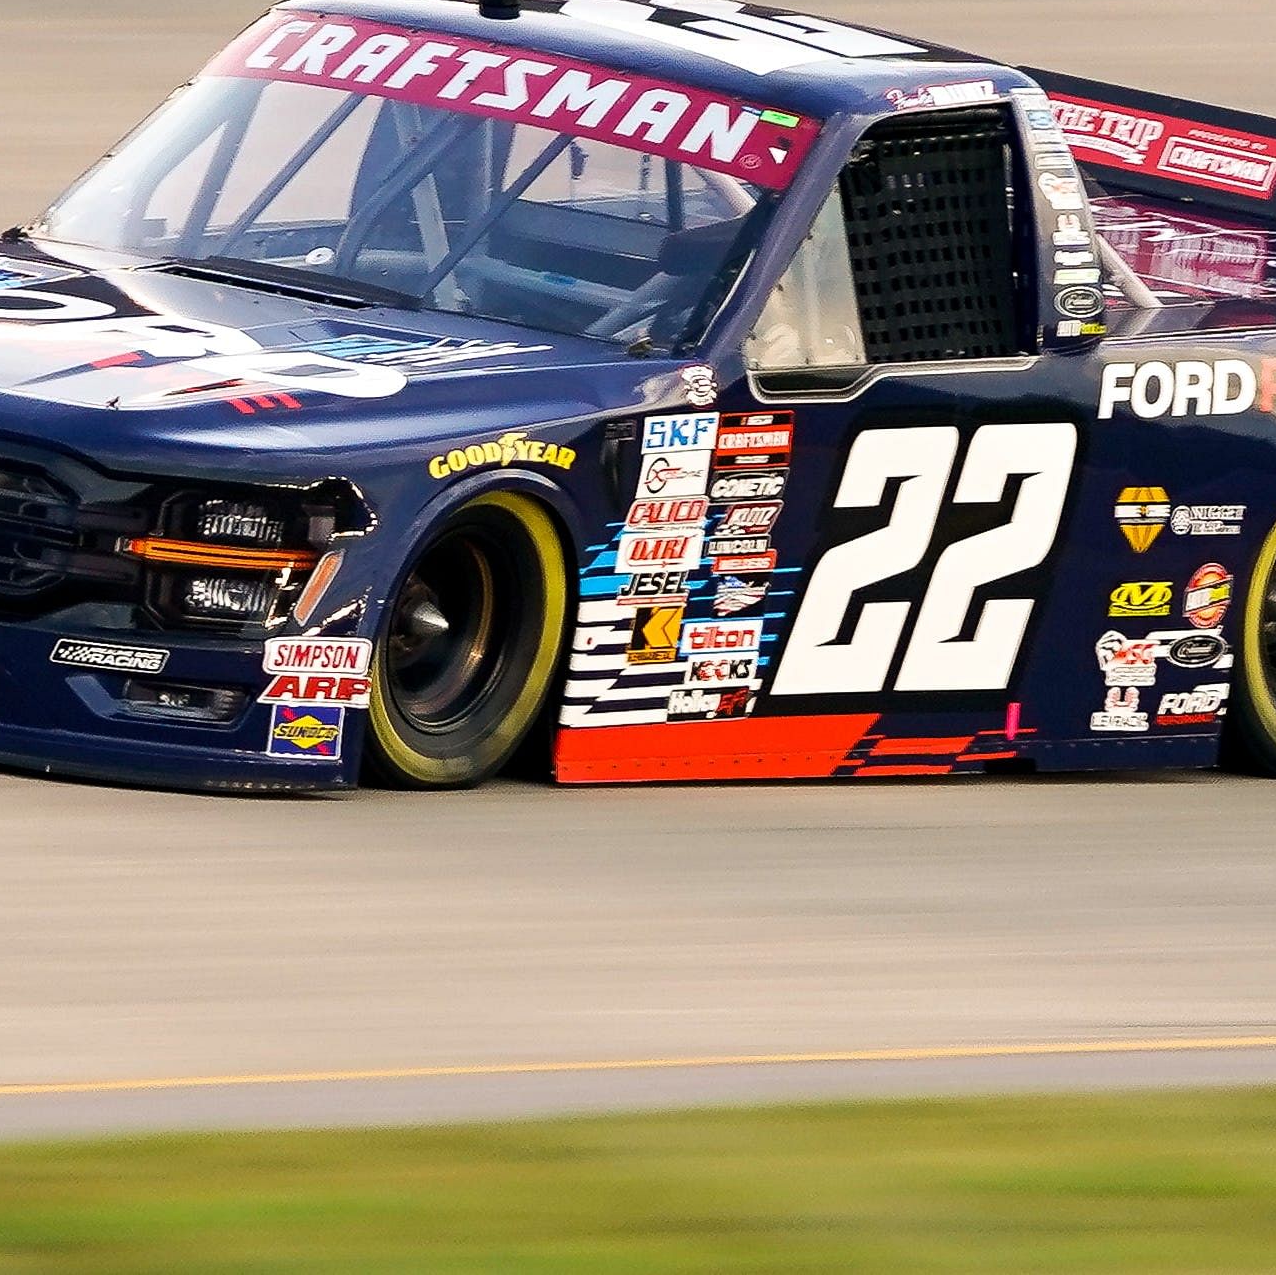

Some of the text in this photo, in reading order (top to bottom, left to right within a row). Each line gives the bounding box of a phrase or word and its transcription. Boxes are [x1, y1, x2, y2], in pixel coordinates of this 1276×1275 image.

[244, 20, 760, 164] CRAFTSMAN
[1099, 110, 1165, 151] TRIP
[1098, 359, 1256, 420] FORD
[645, 417, 716, 449] SKF
[428, 437, 577, 480] GOODYEAR
[629, 500, 705, 525] CALICO
[769, 422, 1078, 696] 22
[620, 571, 689, 596] JESEL
[690, 626, 755, 649] tilton
[88, 653, 161, 670] RACING
[275, 643, 360, 669] SIMPSON
[689, 659, 753, 681] KOOKS
[266, 676, 372, 701] ARP
[275, 725, 337, 741] SUNOCO
